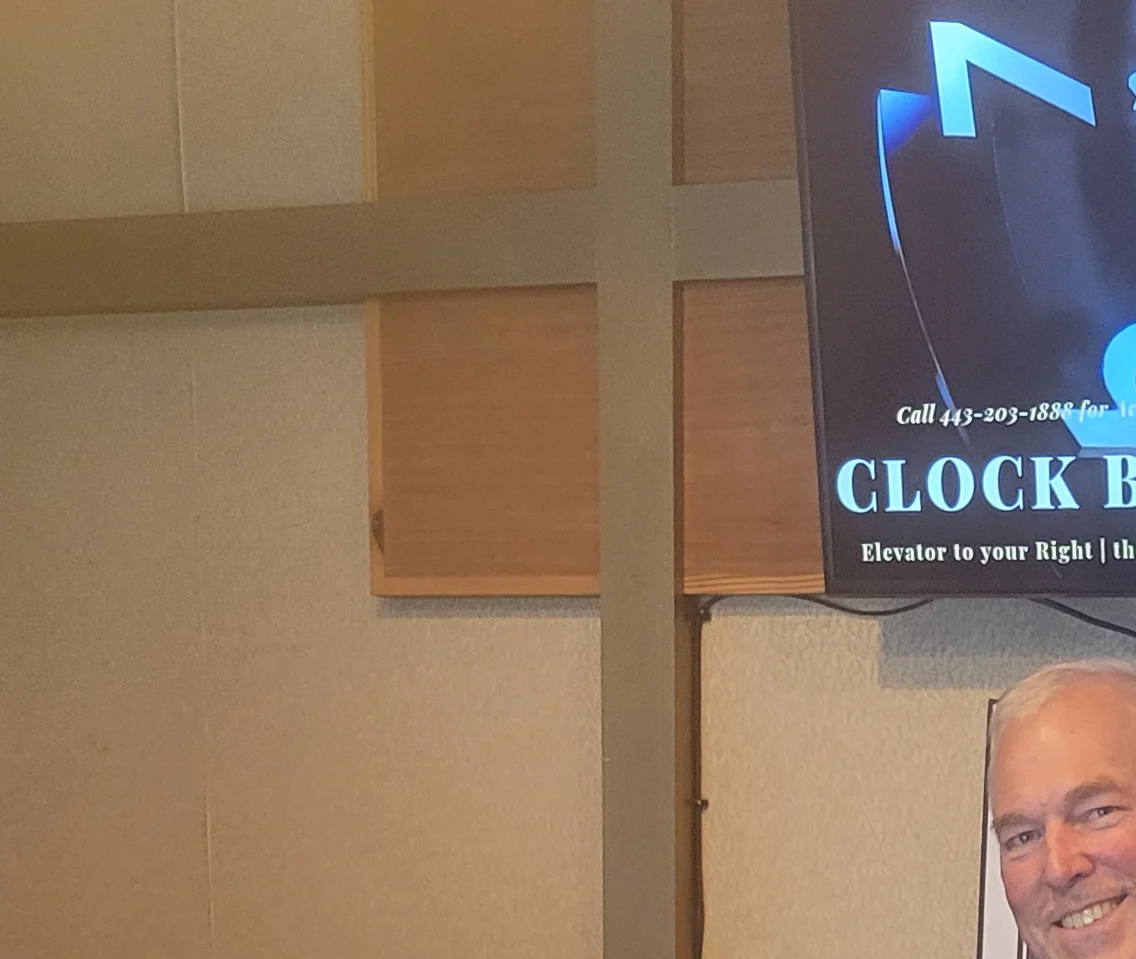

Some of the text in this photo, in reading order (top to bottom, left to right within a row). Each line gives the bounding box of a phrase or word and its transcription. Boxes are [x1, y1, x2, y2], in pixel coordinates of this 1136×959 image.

[897, 403, 935, 425] Call
[939, 401, 1073, 427] 443-203-1888
[1078, 399, 1109, 422] for
[836, 454, 1080, 514] CLOCK
[953, 543, 974, 561] to
[980, 546, 1029, 565] your
[1035, 539, 1094, 564] Right
